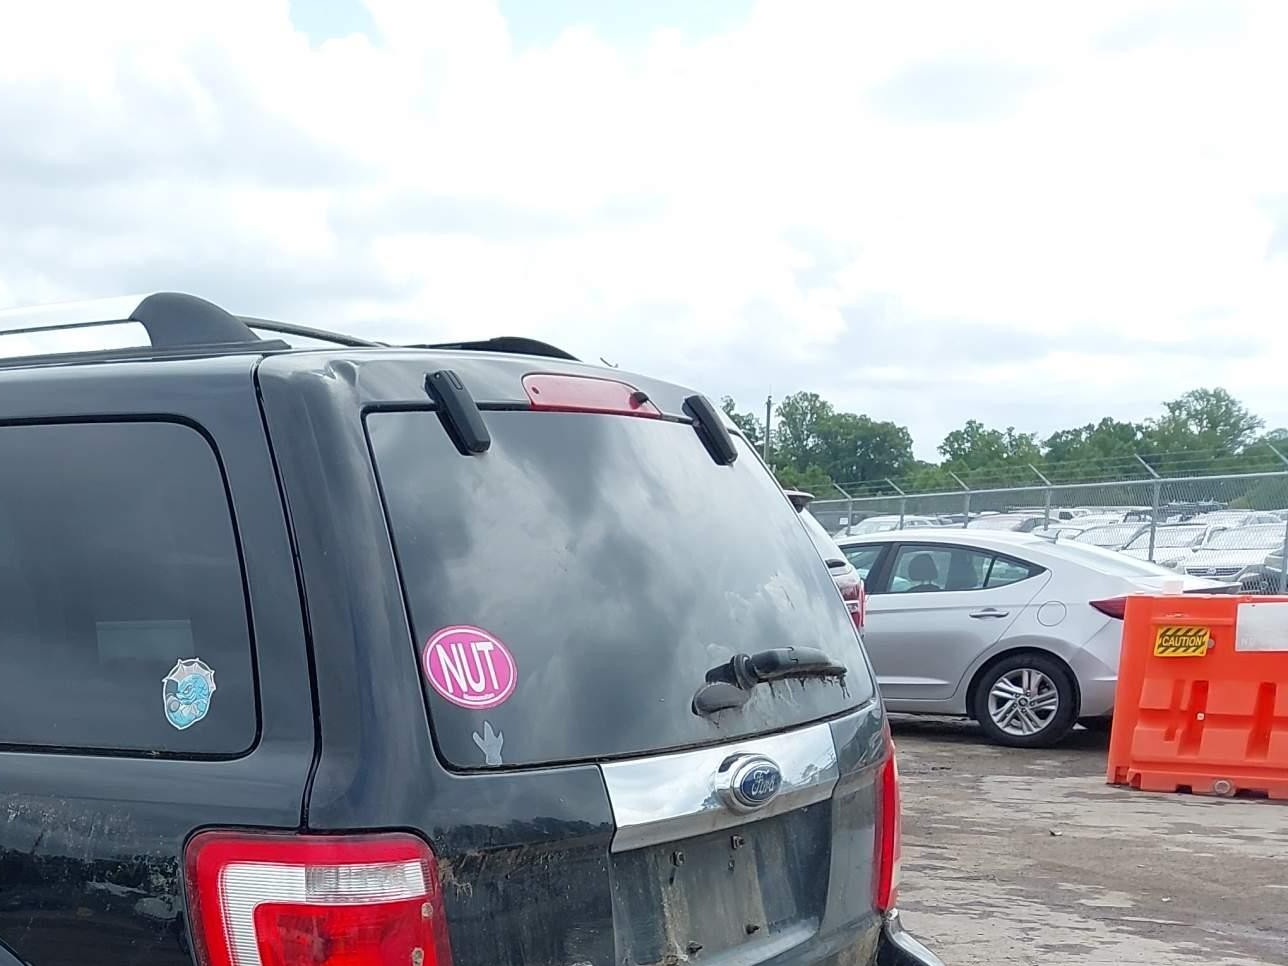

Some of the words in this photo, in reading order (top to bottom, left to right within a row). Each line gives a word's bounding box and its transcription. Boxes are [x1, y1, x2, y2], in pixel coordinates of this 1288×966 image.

[1161, 635, 1203, 648] CAUTION
[435, 641, 500, 694] NUT
[752, 769, 776, 796] Ford
